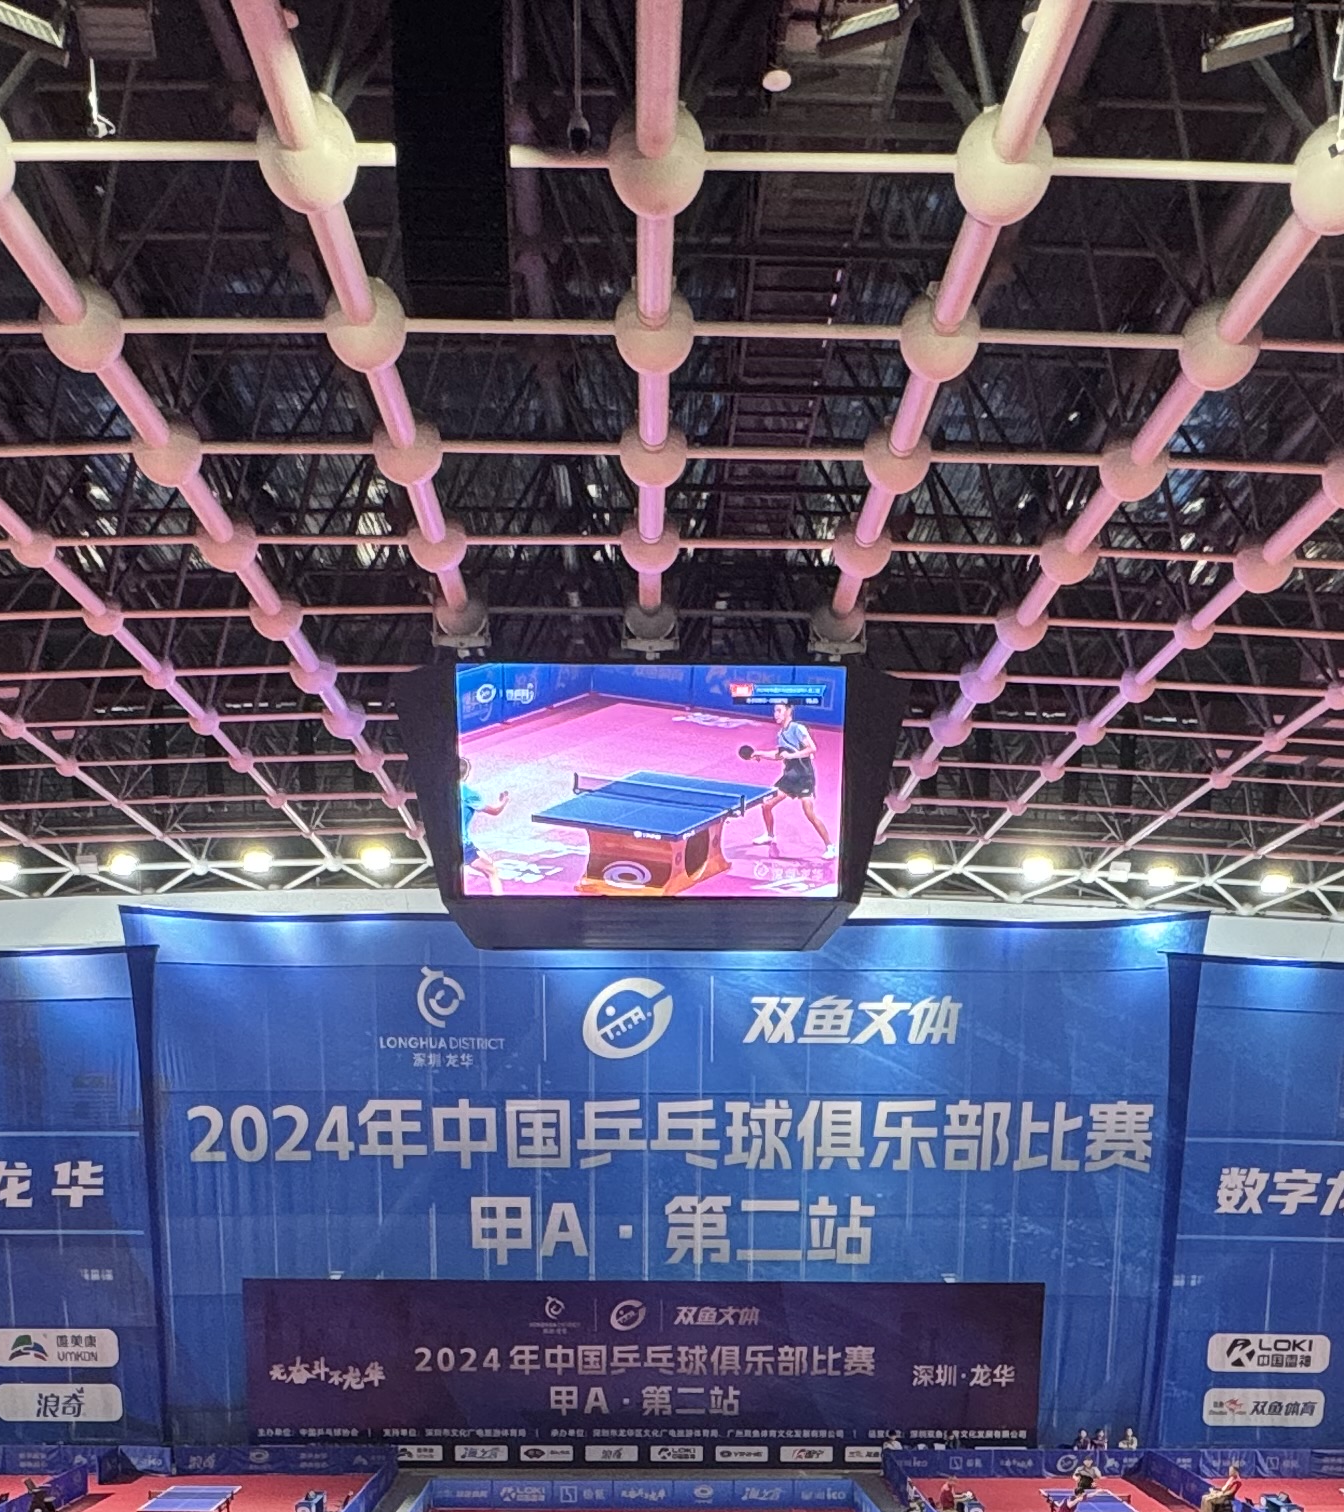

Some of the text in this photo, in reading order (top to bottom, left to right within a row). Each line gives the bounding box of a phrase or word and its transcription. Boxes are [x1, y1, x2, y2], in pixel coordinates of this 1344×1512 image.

[742, 994, 963, 1045] 双鱼文体
[379, 1036, 505, 1051] LONGHUA DISTRICT
[187, 1098, 1155, 1173] 2024年中国乒乓球俱乐部比赛
[470, 1195, 876, 1266] 甲A·第二站
[673, 1305, 760, 1326] 双鱼文体
[1259, 1339, 1314, 1352] LOKI
[414, 1344, 875, 1377] 2024年中国乒乓球俱乐部比赛
[1257, 1353, 1312, 1368] 中国雷神
[912, 1363, 1016, 1388] 深圳·龙华
[36, 1387, 85, 1418] 浪奇
[549, 1384, 741, 1416] 甲A·第二站
[1250, 1400, 1318, 1417] 双鱼体育
